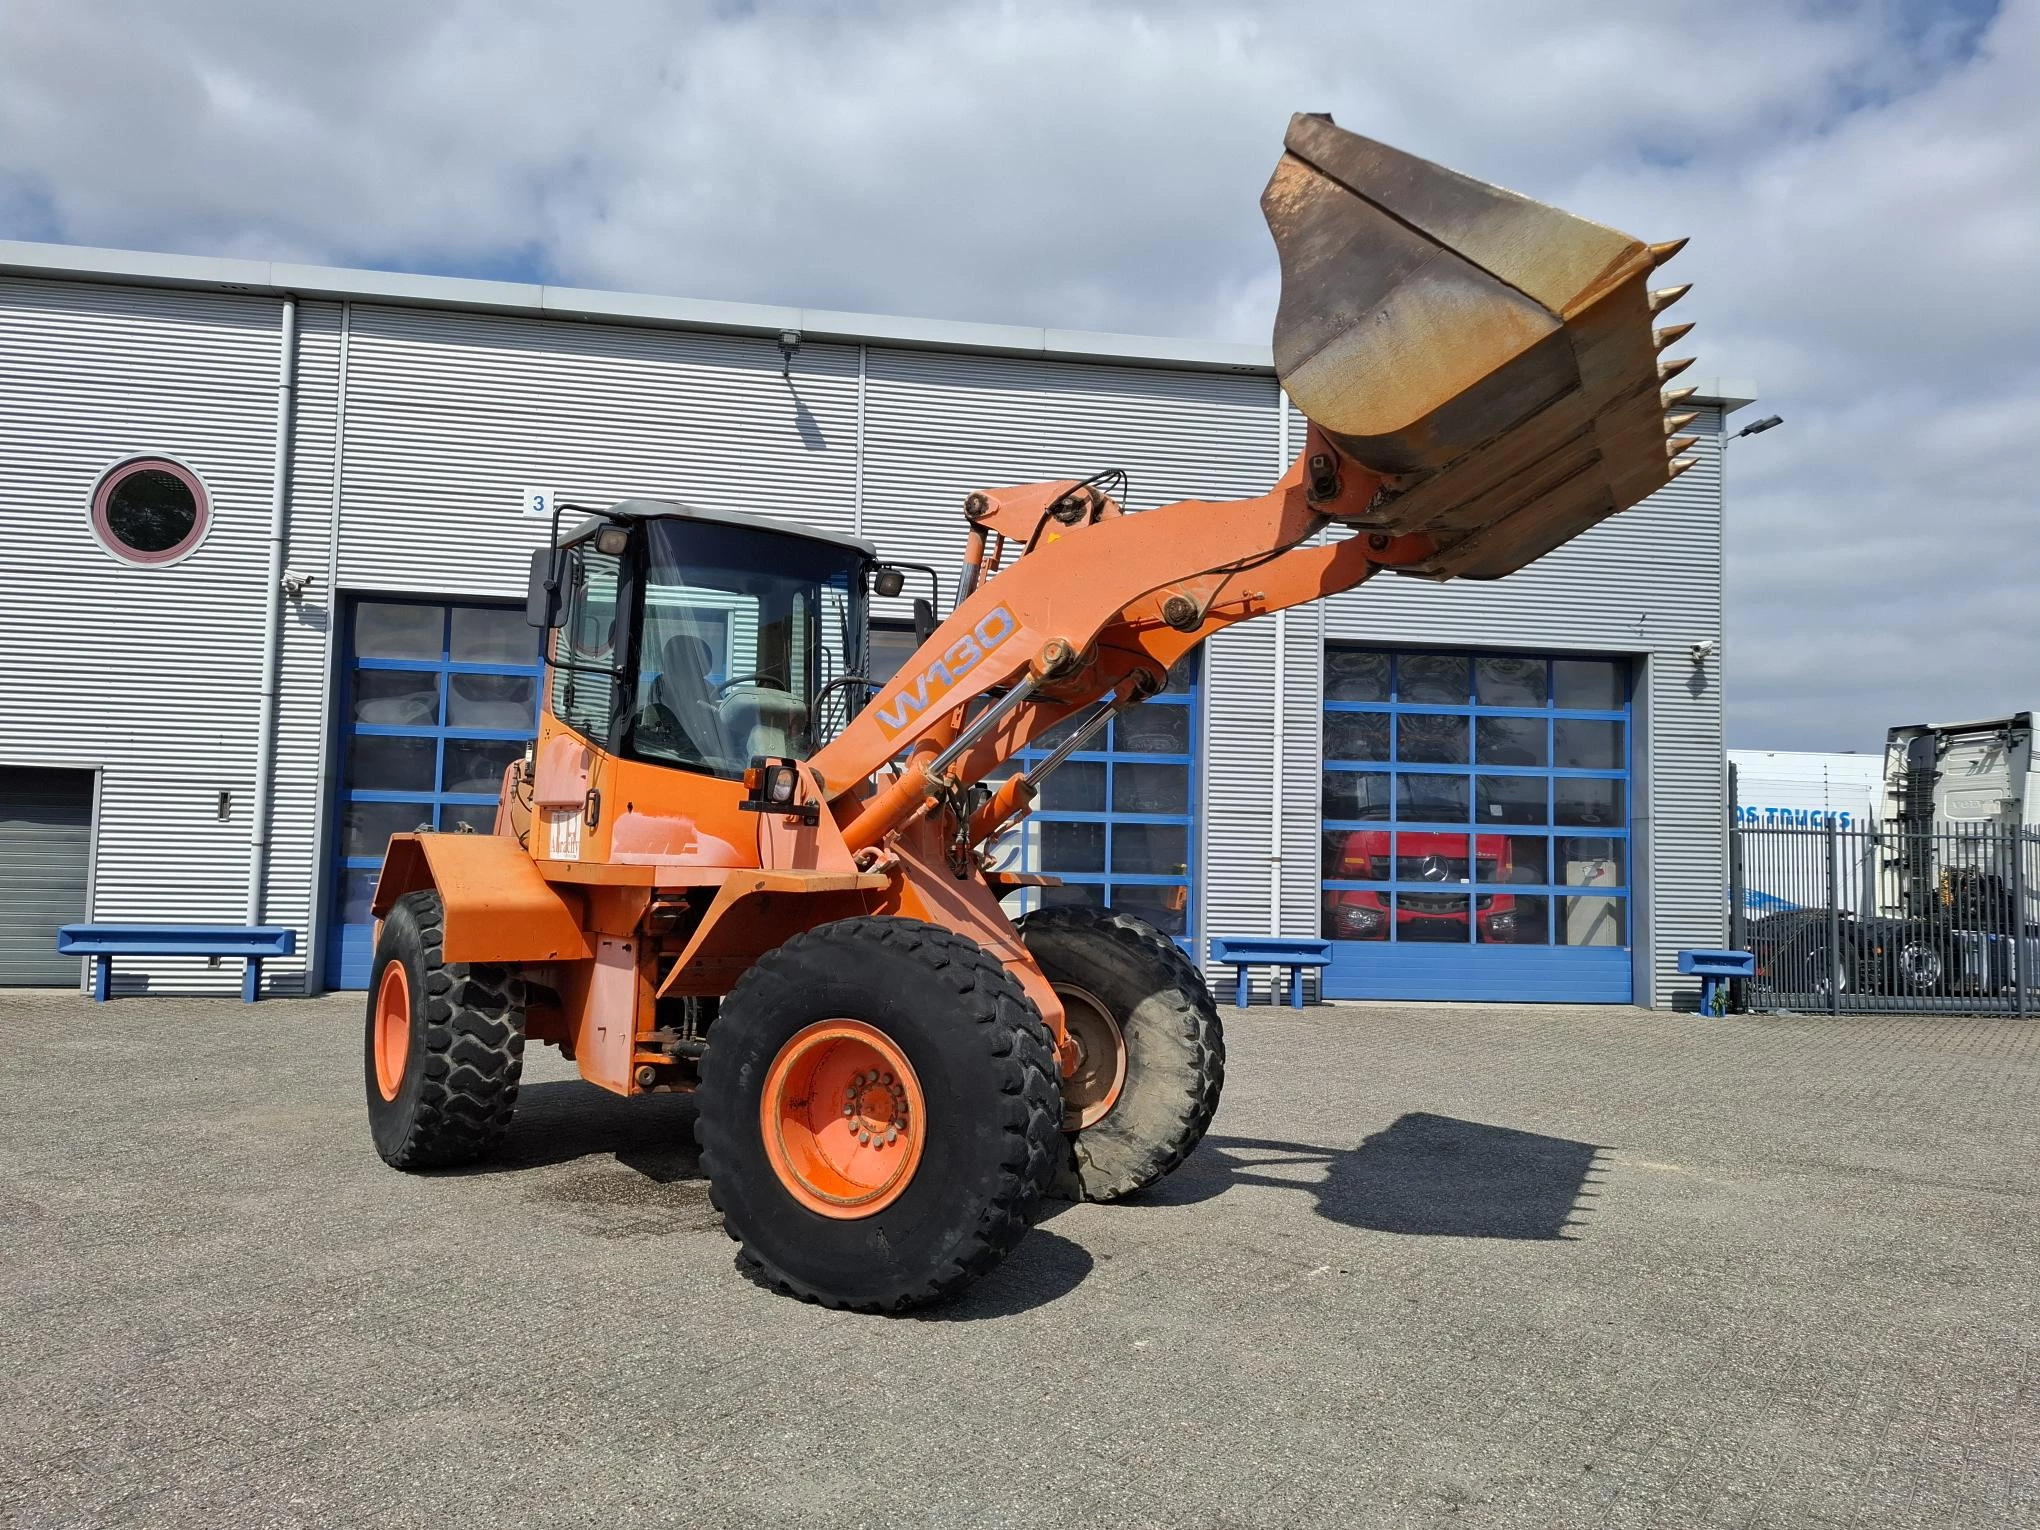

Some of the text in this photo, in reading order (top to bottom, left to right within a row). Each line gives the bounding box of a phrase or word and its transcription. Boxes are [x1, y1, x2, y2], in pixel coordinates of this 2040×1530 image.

[533, 495, 545, 512] 3
[875, 607, 1014, 730] W130
[1765, 807, 1851, 828] TRUCKS
